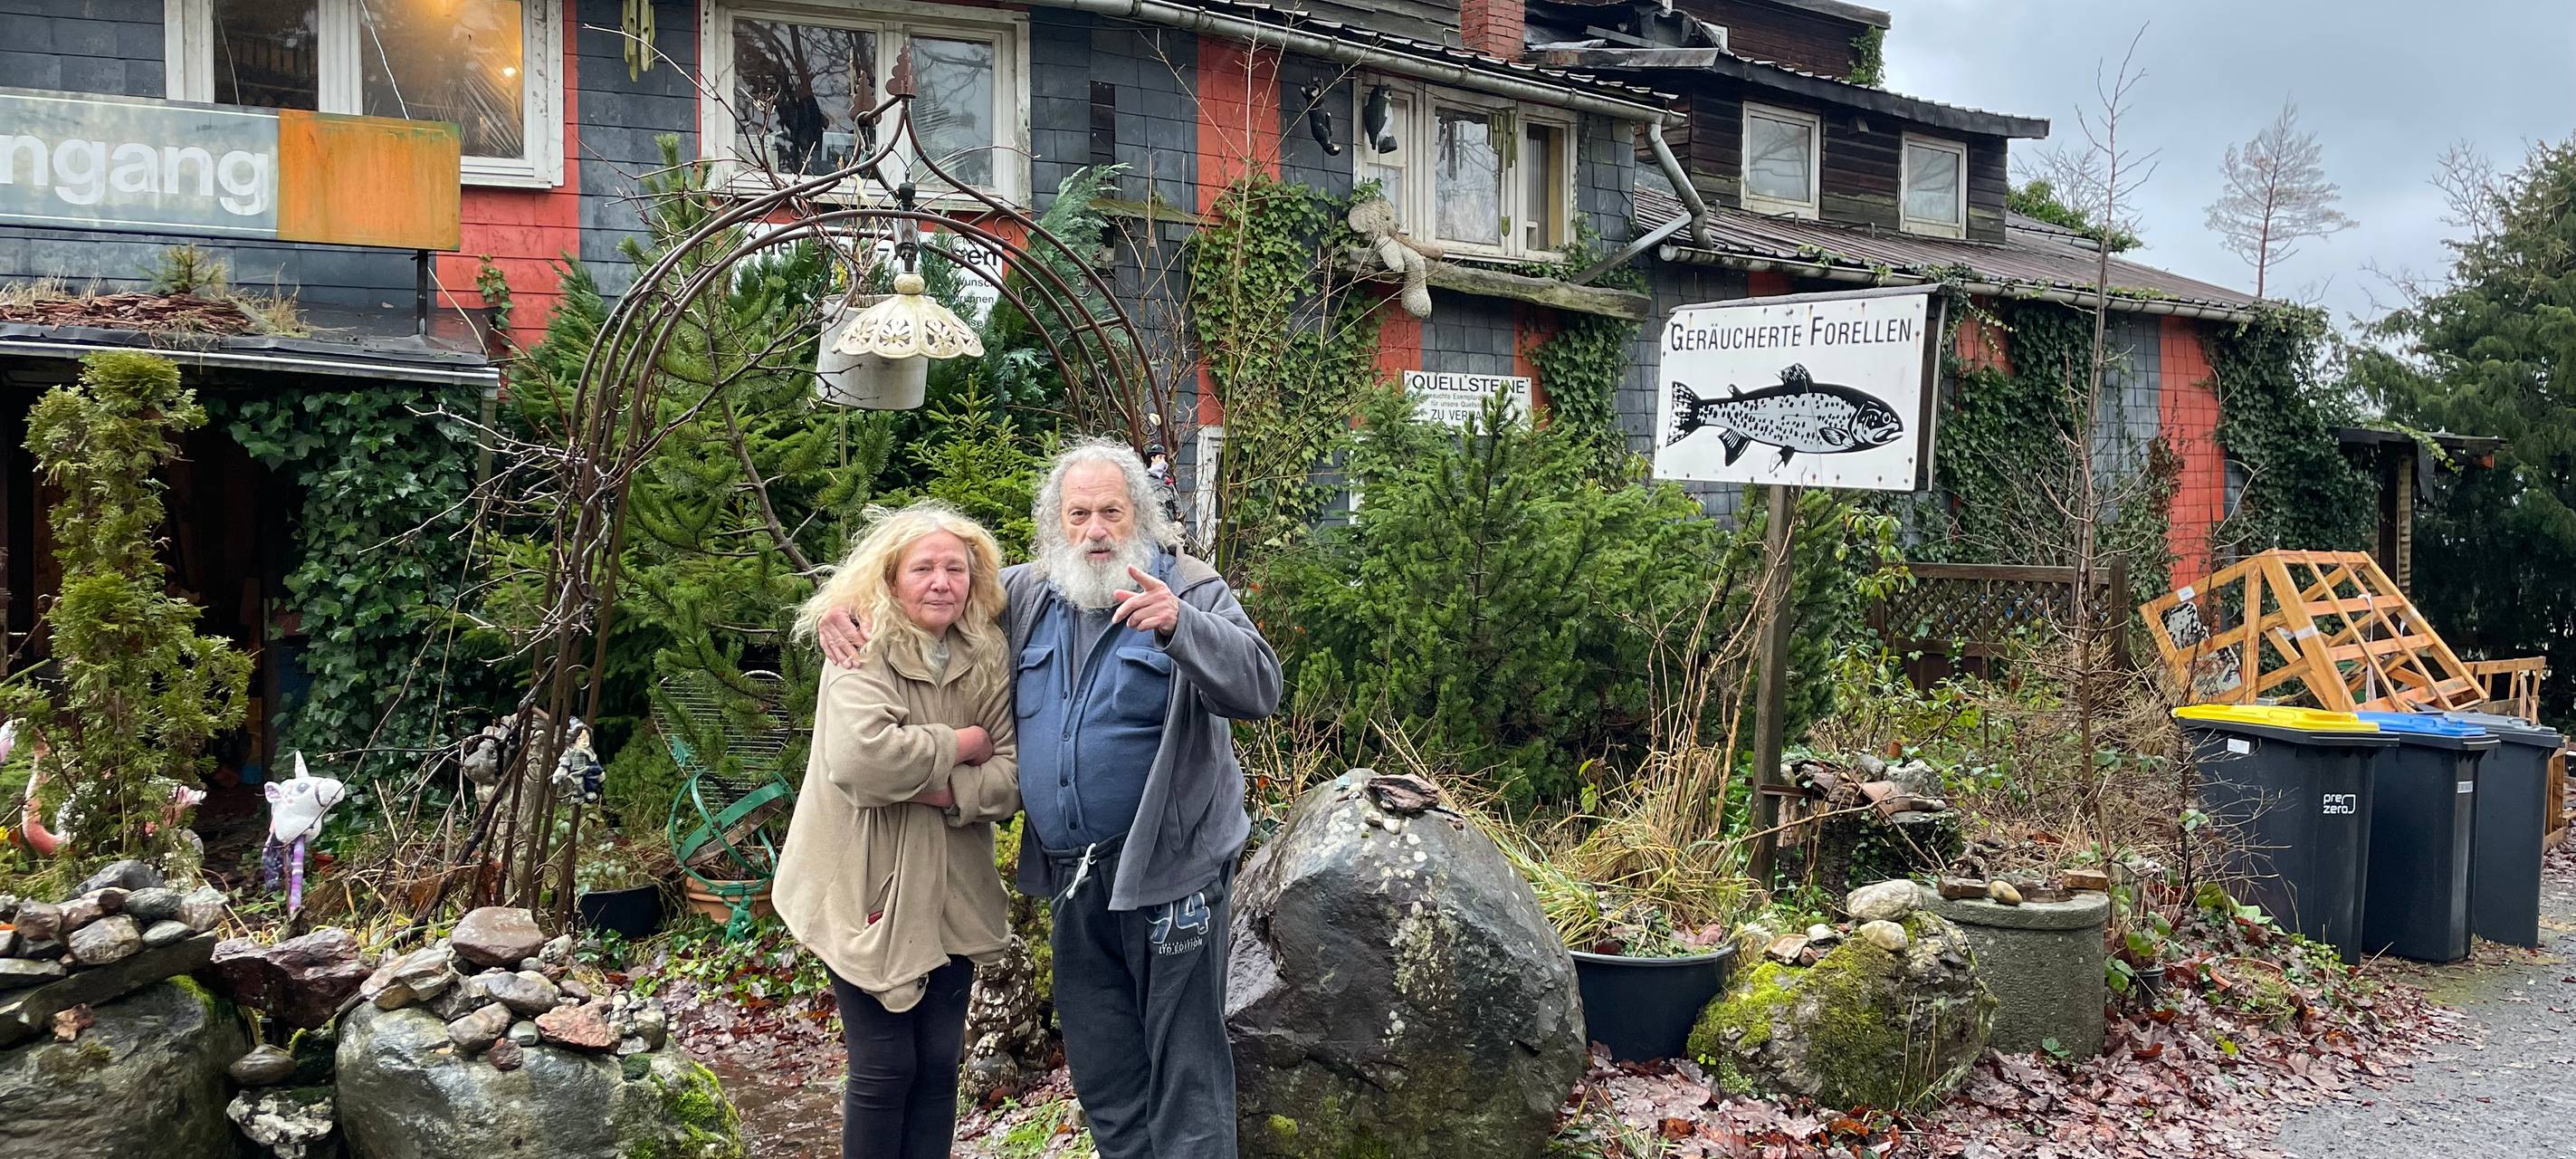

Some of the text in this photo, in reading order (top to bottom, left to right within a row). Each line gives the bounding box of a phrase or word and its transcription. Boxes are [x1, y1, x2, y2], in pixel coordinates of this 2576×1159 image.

[1670, 316, 1912, 351] GERÄUCHERTE FORELLEN
[1412, 374, 1525, 394] QUELLSTENE
[1431, 408, 1445, 420] ZU
[2323, 793, 2342, 805] pre
[2323, 805, 2349, 814] zero
